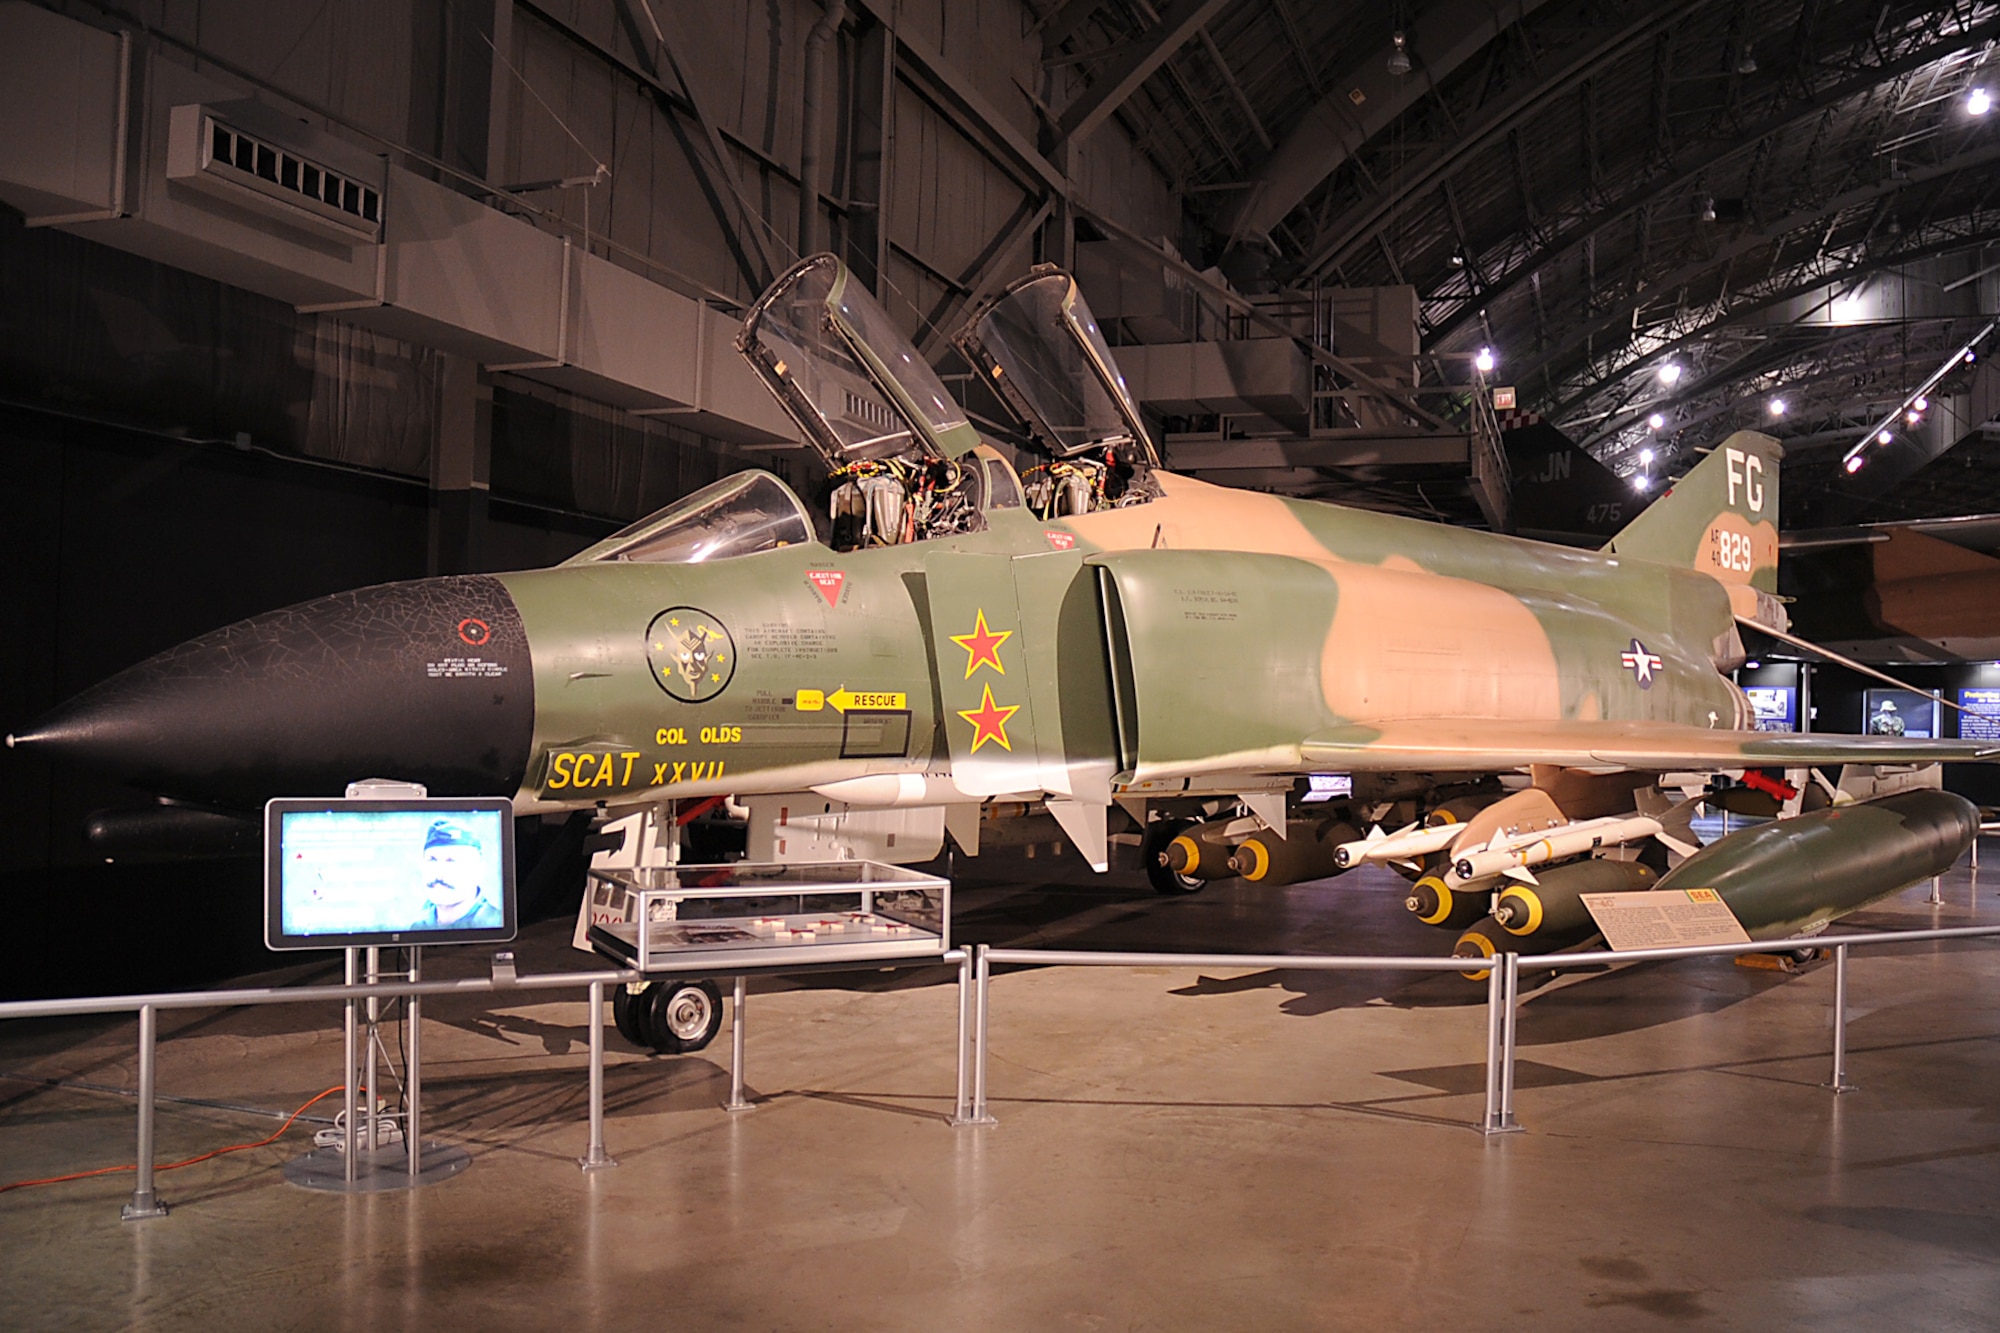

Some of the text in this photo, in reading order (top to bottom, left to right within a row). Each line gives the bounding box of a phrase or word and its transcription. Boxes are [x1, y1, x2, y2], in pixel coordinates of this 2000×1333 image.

[1540, 450, 1571, 482] JN
[1726, 448, 1763, 512] FG
[1587, 503, 1622, 524] 475
[1711, 529, 1719, 544] AF
[1720, 530, 1751, 572] 829
[854, 694, 897, 706] RESCUE
[656, 727, 742, 745] COL OLDS
[548, 752, 724, 789] SCAT XXVII
